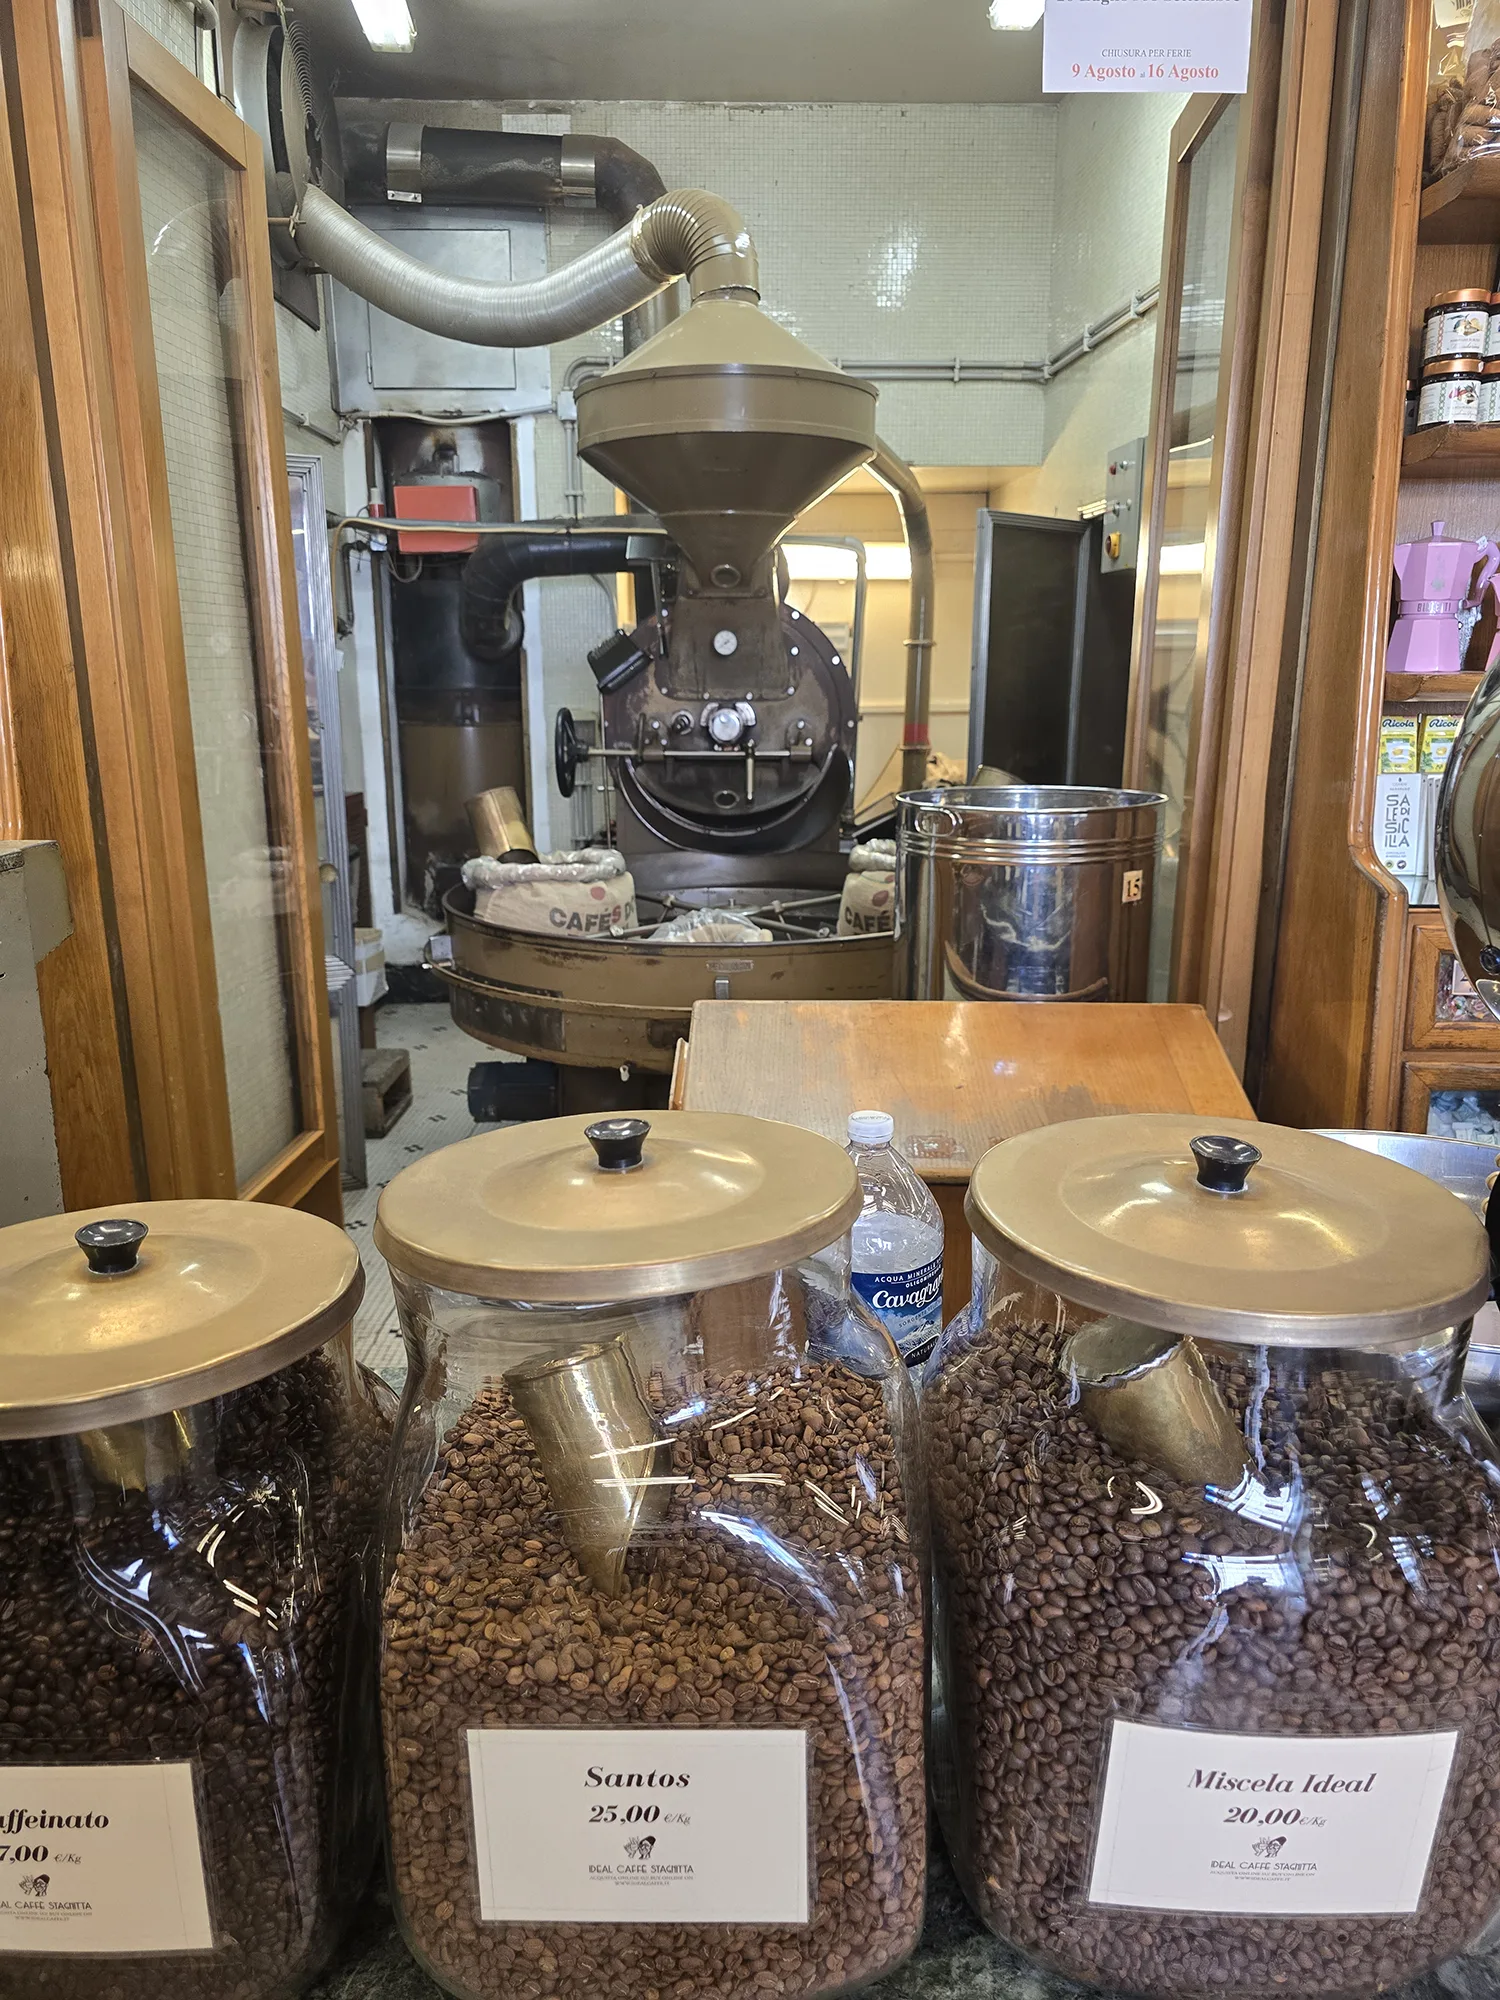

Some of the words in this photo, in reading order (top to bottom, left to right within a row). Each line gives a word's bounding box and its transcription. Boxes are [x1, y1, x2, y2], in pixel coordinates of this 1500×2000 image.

[1101, 48, 1147, 58] CHIUSURA
[1148, 49, 1165, 58] PER
[1166, 49, 1192, 58] FERIE
[1071, 63, 1081, 78] 9
[1084, 63, 1136, 81] Agosto
[1148, 63, 1165, 78] 16
[1168, 63, 1219, 82] Agosto
[1382, 718, 1415, 728] Ricola
[1127, 878, 1140, 897] 15
[874, 1275, 904, 1283] ACQUA
[584, 1765, 691, 1788] Santos
[1187, 1768, 1294, 1793] Miscela
[1300, 1773, 1377, 1793] Ideal
[588, 1804, 661, 1826] 25,00
[664, 1812, 692, 1826] €/Kg
[1223, 1806, 1301, 1826] 20,00
[1300, 1816, 1327, 1827] €/Kg
[54, 1853, 82, 1865] €/Kg
[1210, 1860, 1236, 1869] IDEAL
[588, 1864, 613, 1873] IDEAL
